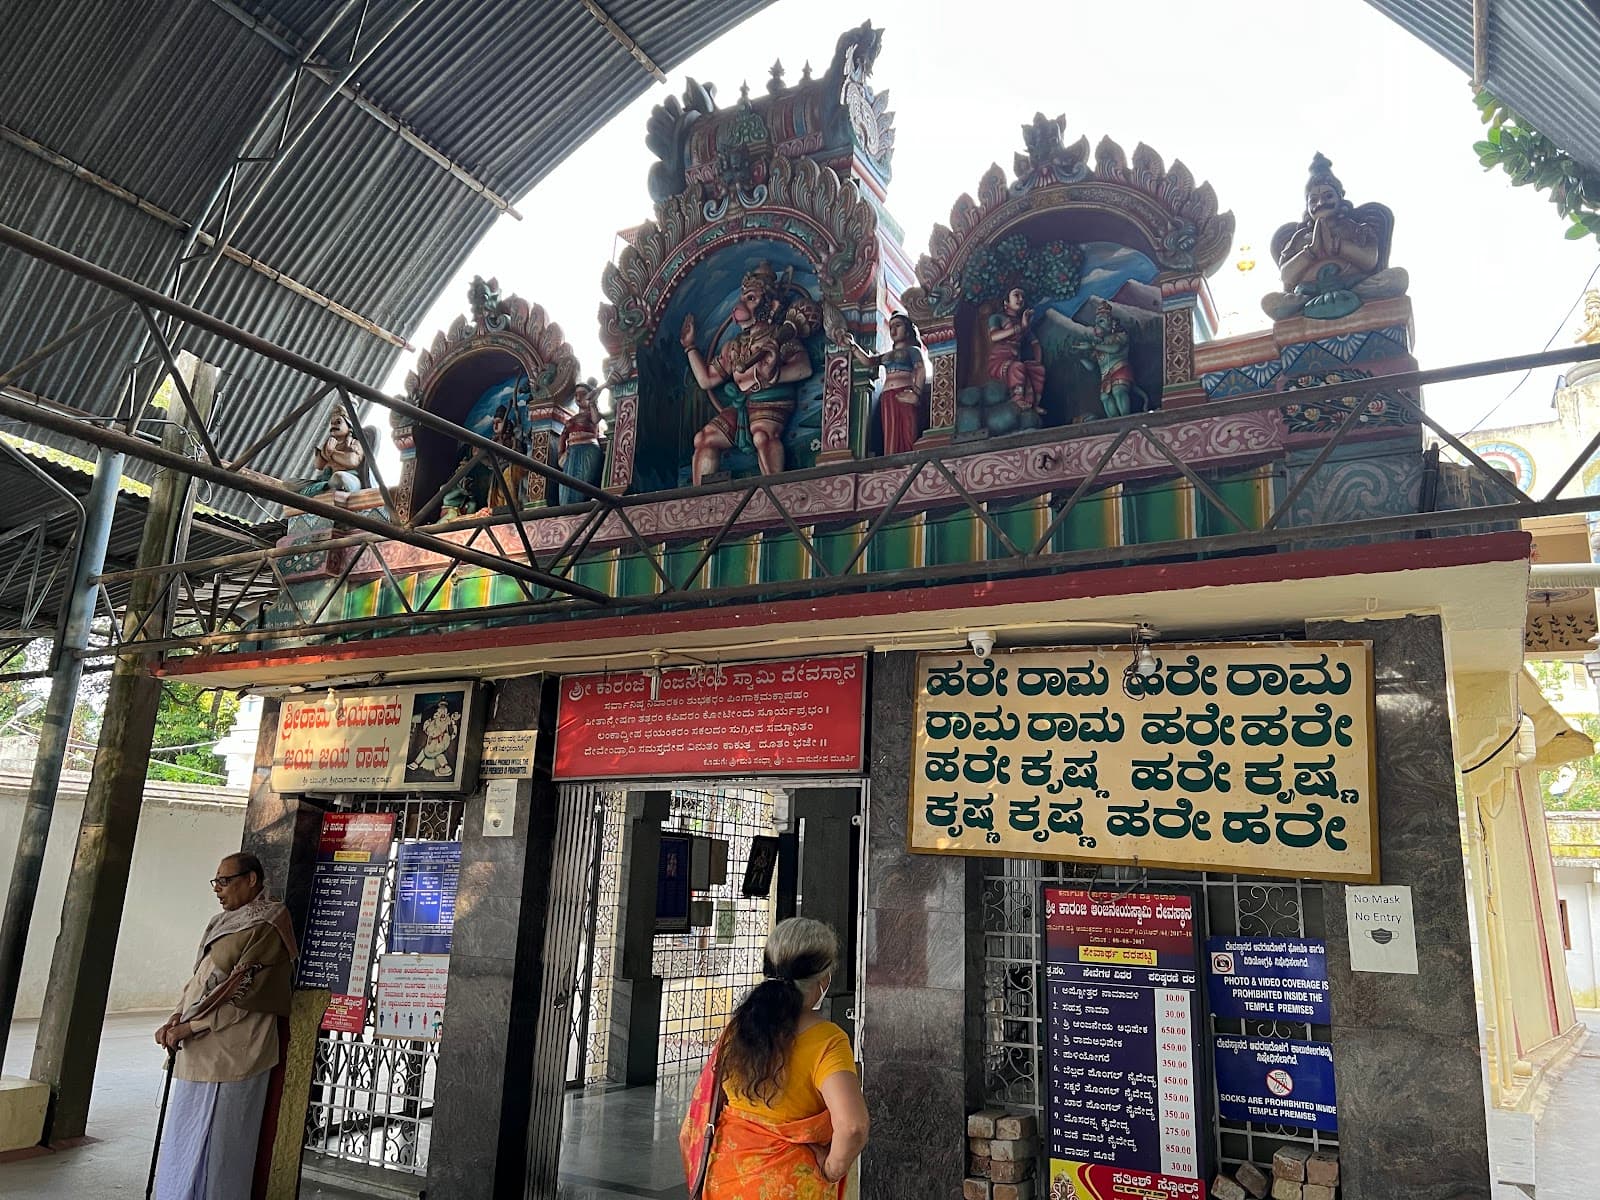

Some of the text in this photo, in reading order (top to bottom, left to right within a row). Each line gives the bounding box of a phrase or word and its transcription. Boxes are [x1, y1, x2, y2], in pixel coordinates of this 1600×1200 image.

[568, 662, 856, 701] ಶ್ರೀ ಕಾರಂಜಿ ಂಜನೇಯ ಸ್ವಾಮಿ ದೇವಸ್ಥಾನ
[927, 654, 1352, 696] ಹರೇ ರಾಮ ಹರೇ ರಾಮ
[336, 695, 402, 728] ಜಯರಾಮ
[925, 703, 1353, 747] ರಾಮ ರಾಮ ಹರೇ ಹರೇ
[284, 737, 390, 770] ಜಯ ಜಯ ರಾಮ
[925, 746, 1360, 804] ಹರೇ ಕೃಷ್ಣ ಹರೇ ಕೃಷ್ಣ
[926, 792, 1348, 851] ಕೃಷ್ಣ ಕೃಷ್ಣ ಹರೇ ಹರೇ
[1354, 894, 1401, 904] No Mask
[1355, 912, 1402, 925] No Entry
[1224, 976, 1329, 990] PHOTO & VIDEO COVERAGE IS
[1165, 994, 1185, 1002] 10.00
[1232, 989, 1323, 1002] PROHIBHITED INSIDE THE
[1165, 1010, 1186, 1019] 30.00
[1244, 1002, 1314, 1015] TEMPLE PREMISES
[1161, 1027, 1187, 1036] 650.00
[1161, 1043, 1187, 1052] 450.00
[1162, 1059, 1188, 1069] 350.00
[1163, 1076, 1188, 1086] 450.00
[1163, 1092, 1189, 1103] 350.00
[1220, 1093, 1337, 1114] SOCKS ARE PROHIBHITED INSIDE
[1164, 1110, 1190, 1120] 350.00
[1247, 1106, 1317, 1122] TEMPLE PREMISES
[1165, 1127, 1191, 1137] 275.00
[1165, 1144, 1191, 1155] 850.00
[1171, 1162, 1192, 1172] 30.00
